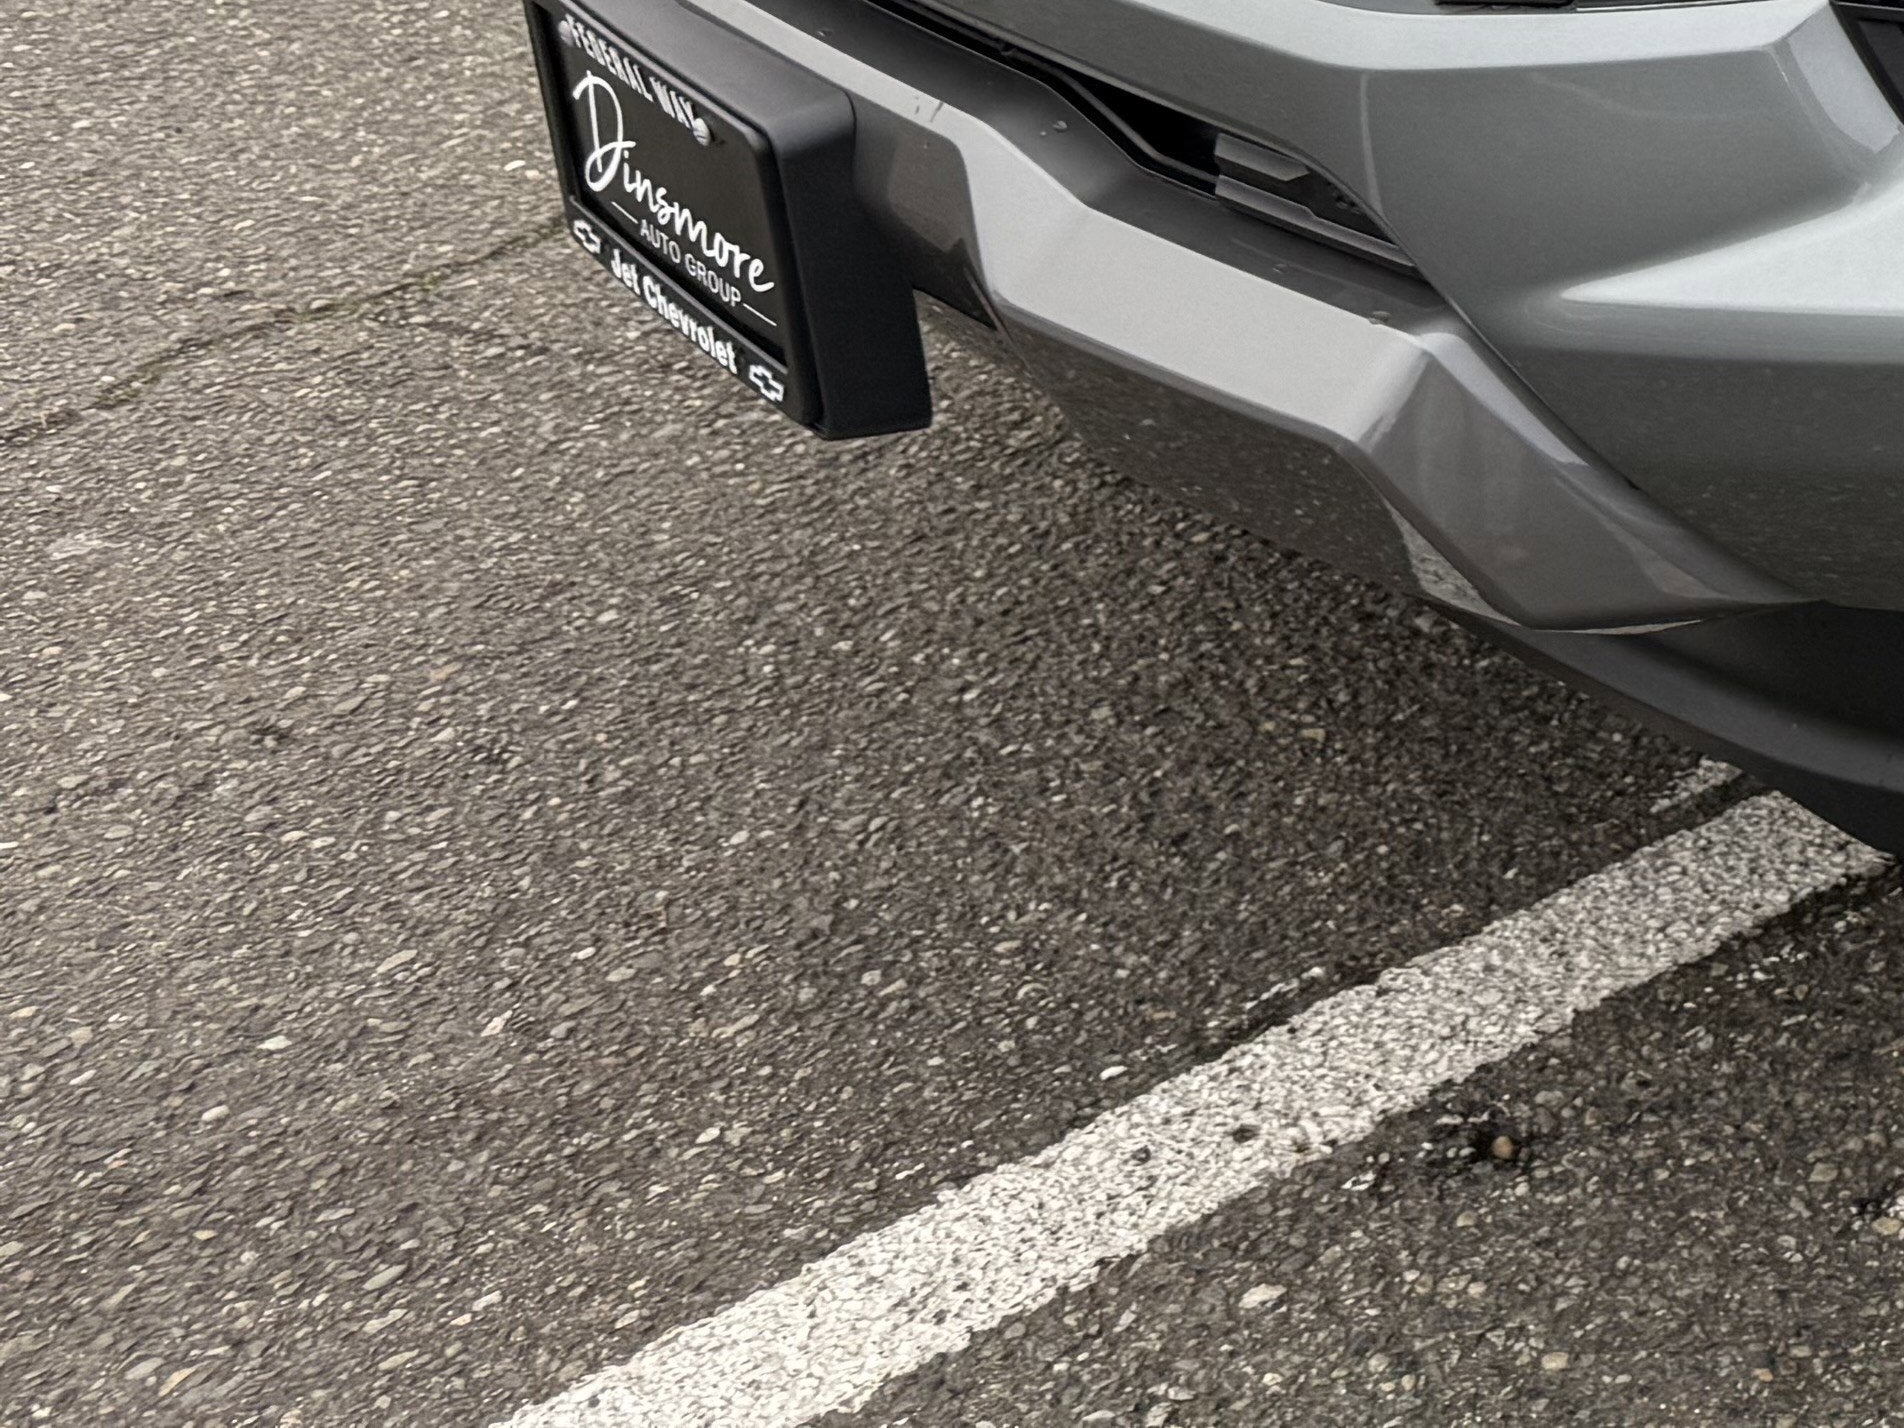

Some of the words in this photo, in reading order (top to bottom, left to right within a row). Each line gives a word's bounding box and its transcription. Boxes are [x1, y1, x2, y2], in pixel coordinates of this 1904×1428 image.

[565, 13, 654, 102] FEDERAL
[572, 69, 775, 293] Dinsmore
[610, 249, 641, 295] Jet
[643, 275, 738, 374] Chevrolet
[640, 219, 681, 263] AUTO
[685, 253, 741, 306] GROUP
